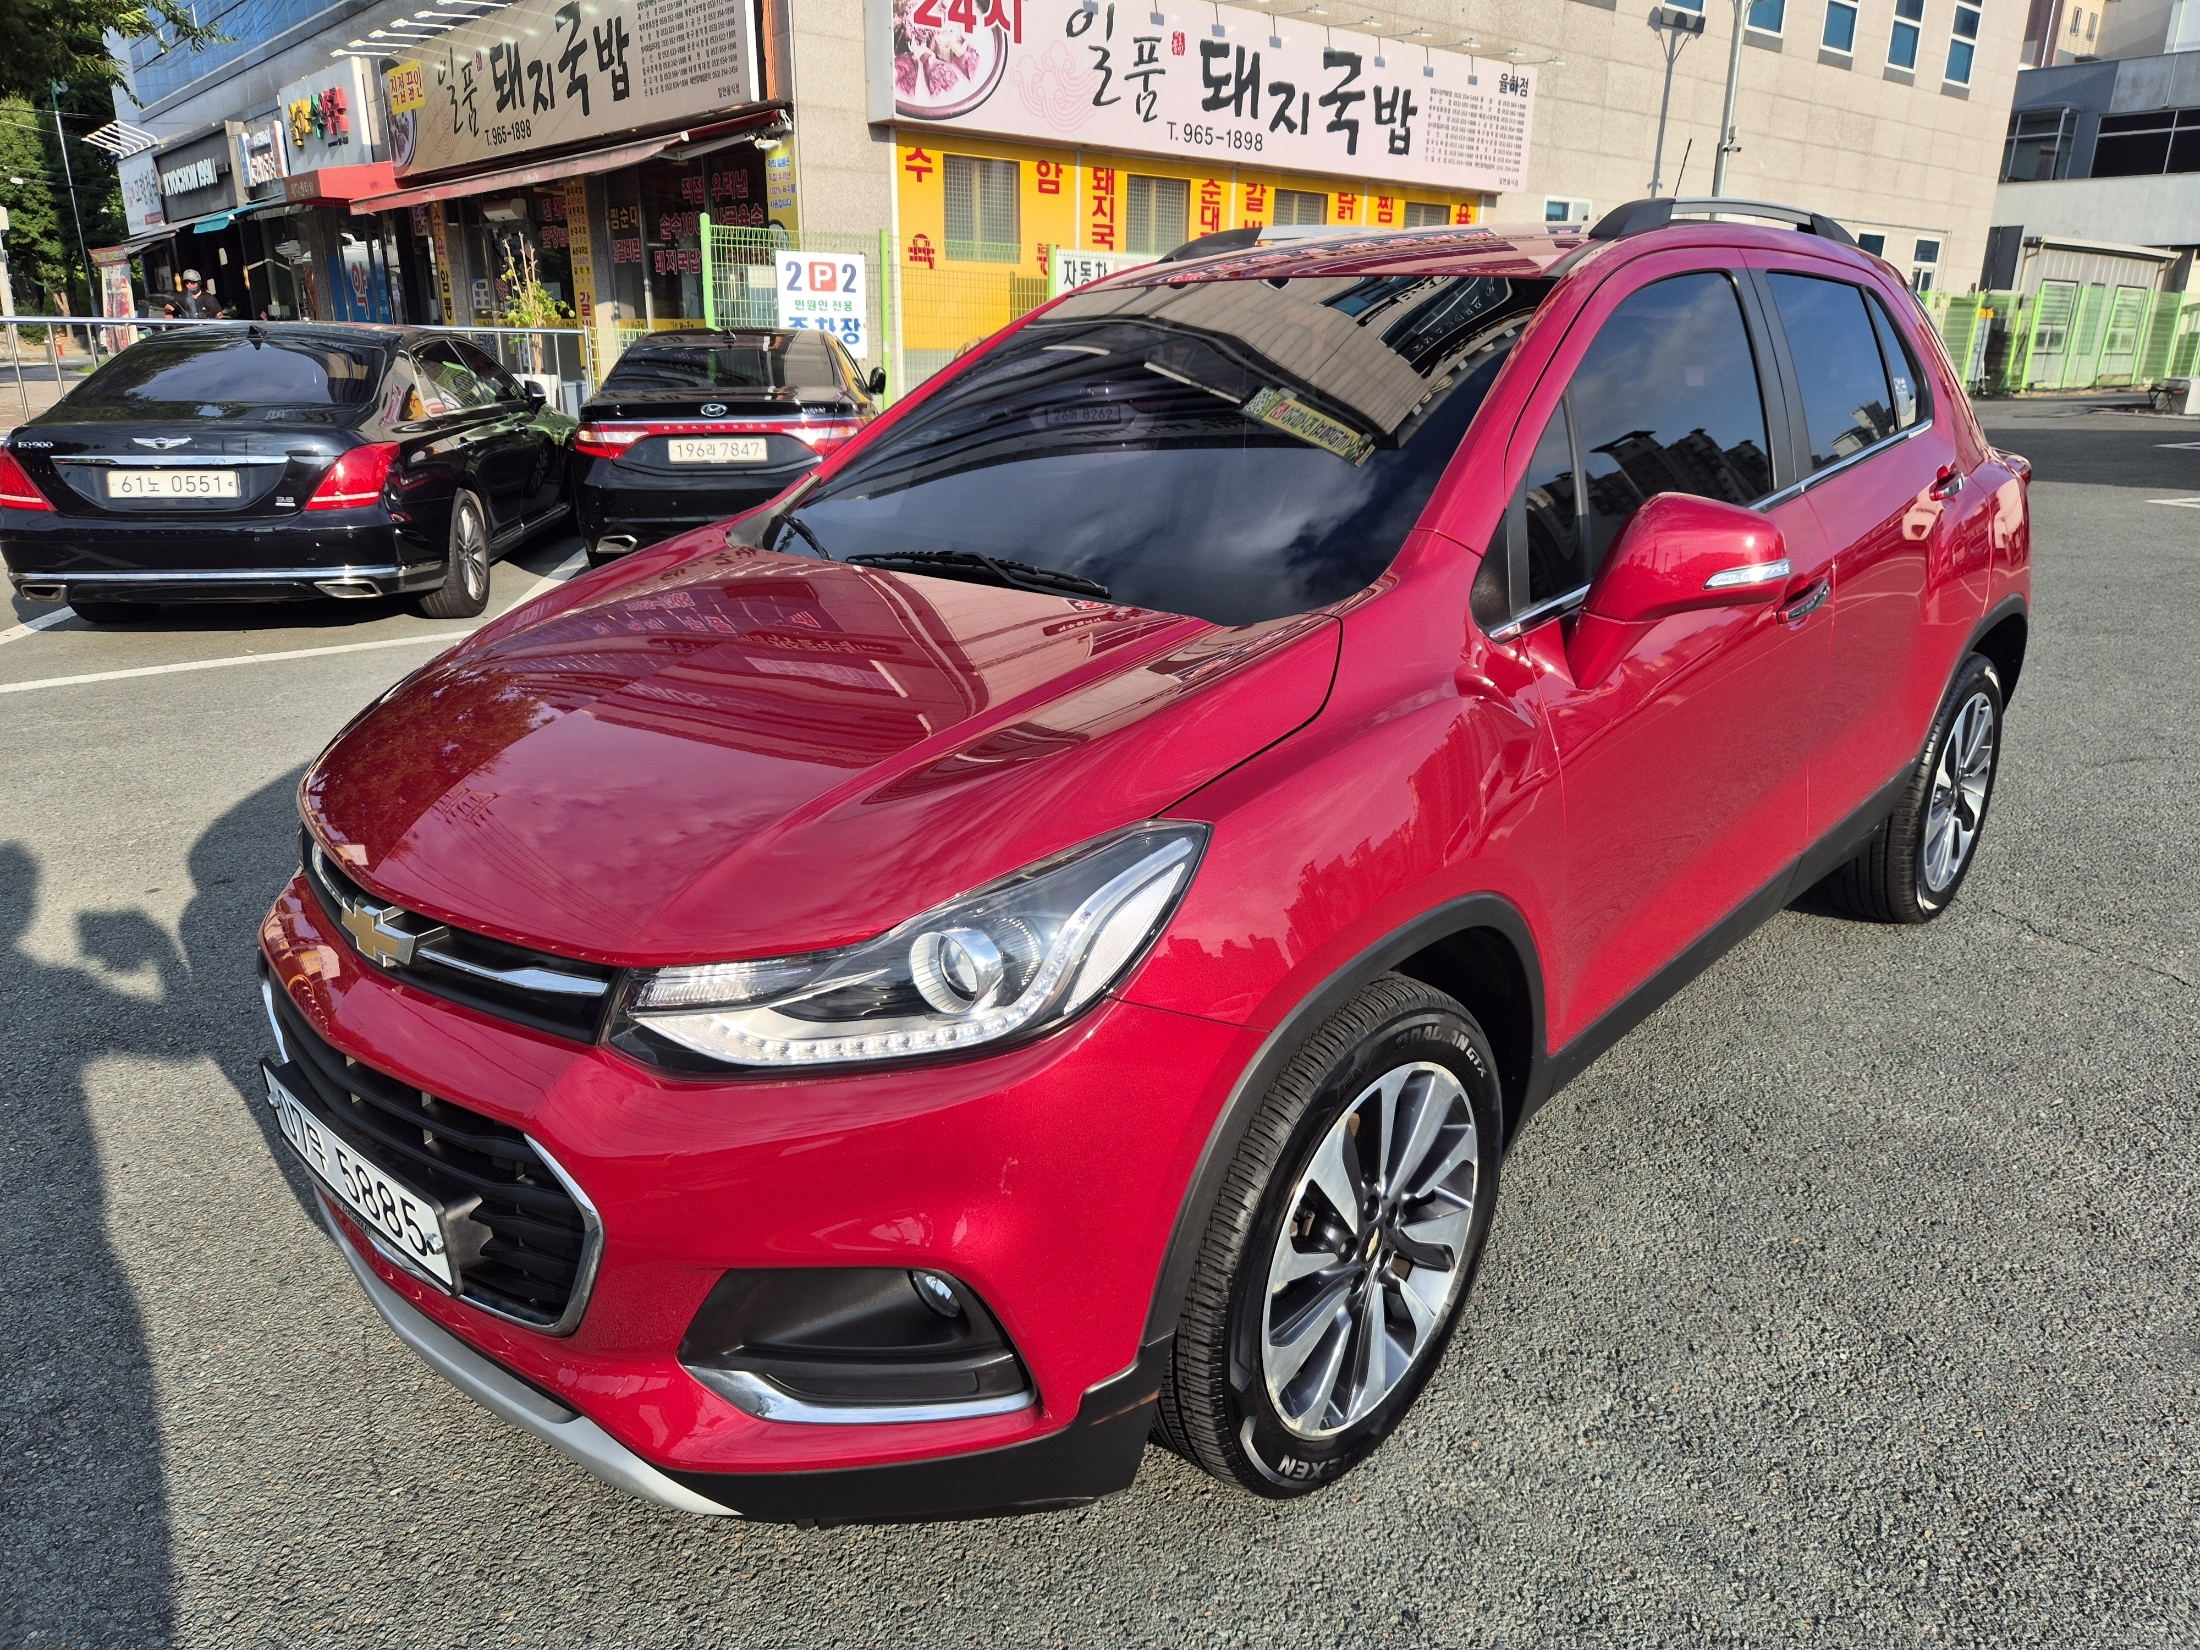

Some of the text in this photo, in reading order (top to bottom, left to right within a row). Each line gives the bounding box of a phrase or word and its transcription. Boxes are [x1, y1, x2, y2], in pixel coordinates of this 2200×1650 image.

[437, 46, 480, 138] 일품
[489, 1, 630, 117] 돼지국밥
[1065, 2, 1167, 123] 일품
[1200, 38, 1419, 156] 돼지국밥
[1498, 72, 1530, 98] 율하점
[162, 162, 198, 197] KYOCHON
[711, 168, 749, 202] 우려낸
[654, 247, 701, 276] 돼지국밥
[785, 261, 802, 291] 2
[842, 263, 857, 293] 2
[351, 261, 370, 320] 약
[794, 299, 853, 313] 민원인 전용
[121, 475, 222, 493] 61노 0551
[1465, 1046, 1487, 1079] GTX
[277, 1088, 429, 1257] 07무 5885
[341, 1203, 372, 1236] CHEVROLET
